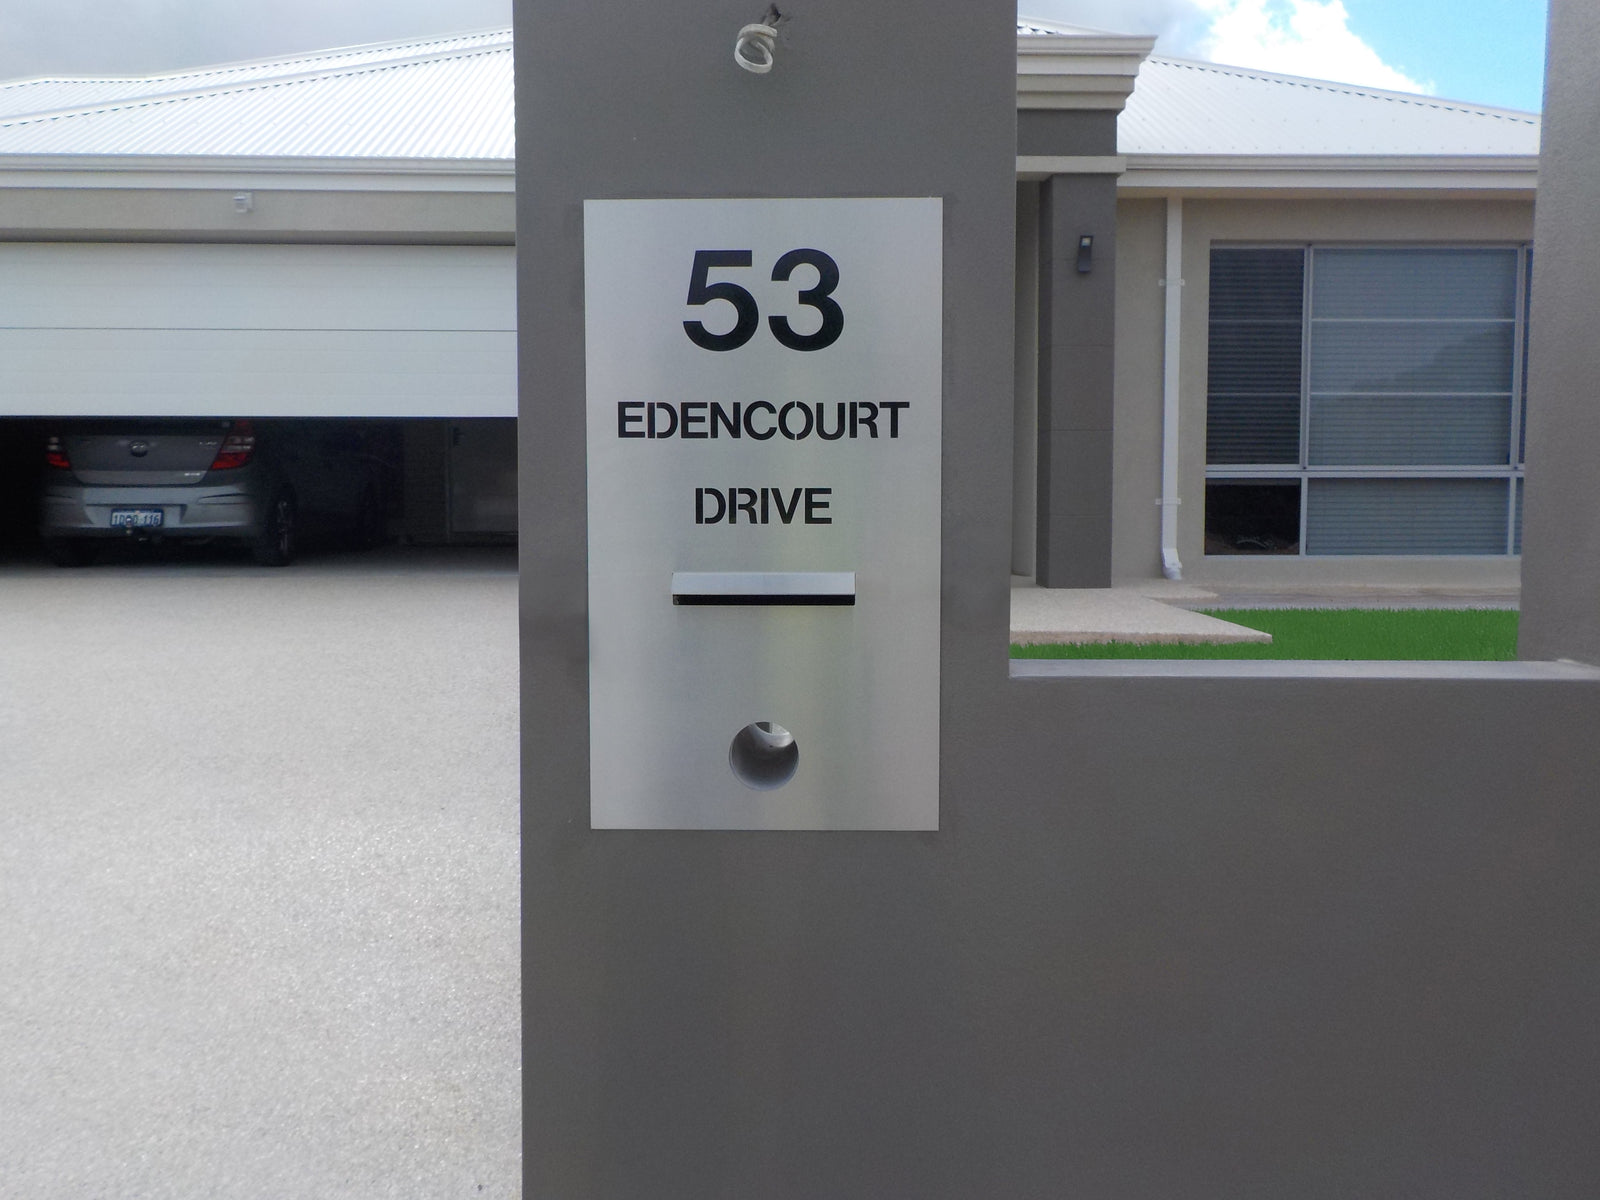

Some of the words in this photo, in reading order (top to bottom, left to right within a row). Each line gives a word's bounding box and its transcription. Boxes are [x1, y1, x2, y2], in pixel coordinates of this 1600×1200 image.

[682, 248, 845, 352] 53
[617, 401, 910, 441] EDENCOURT
[695, 487, 833, 525] DRIVE
